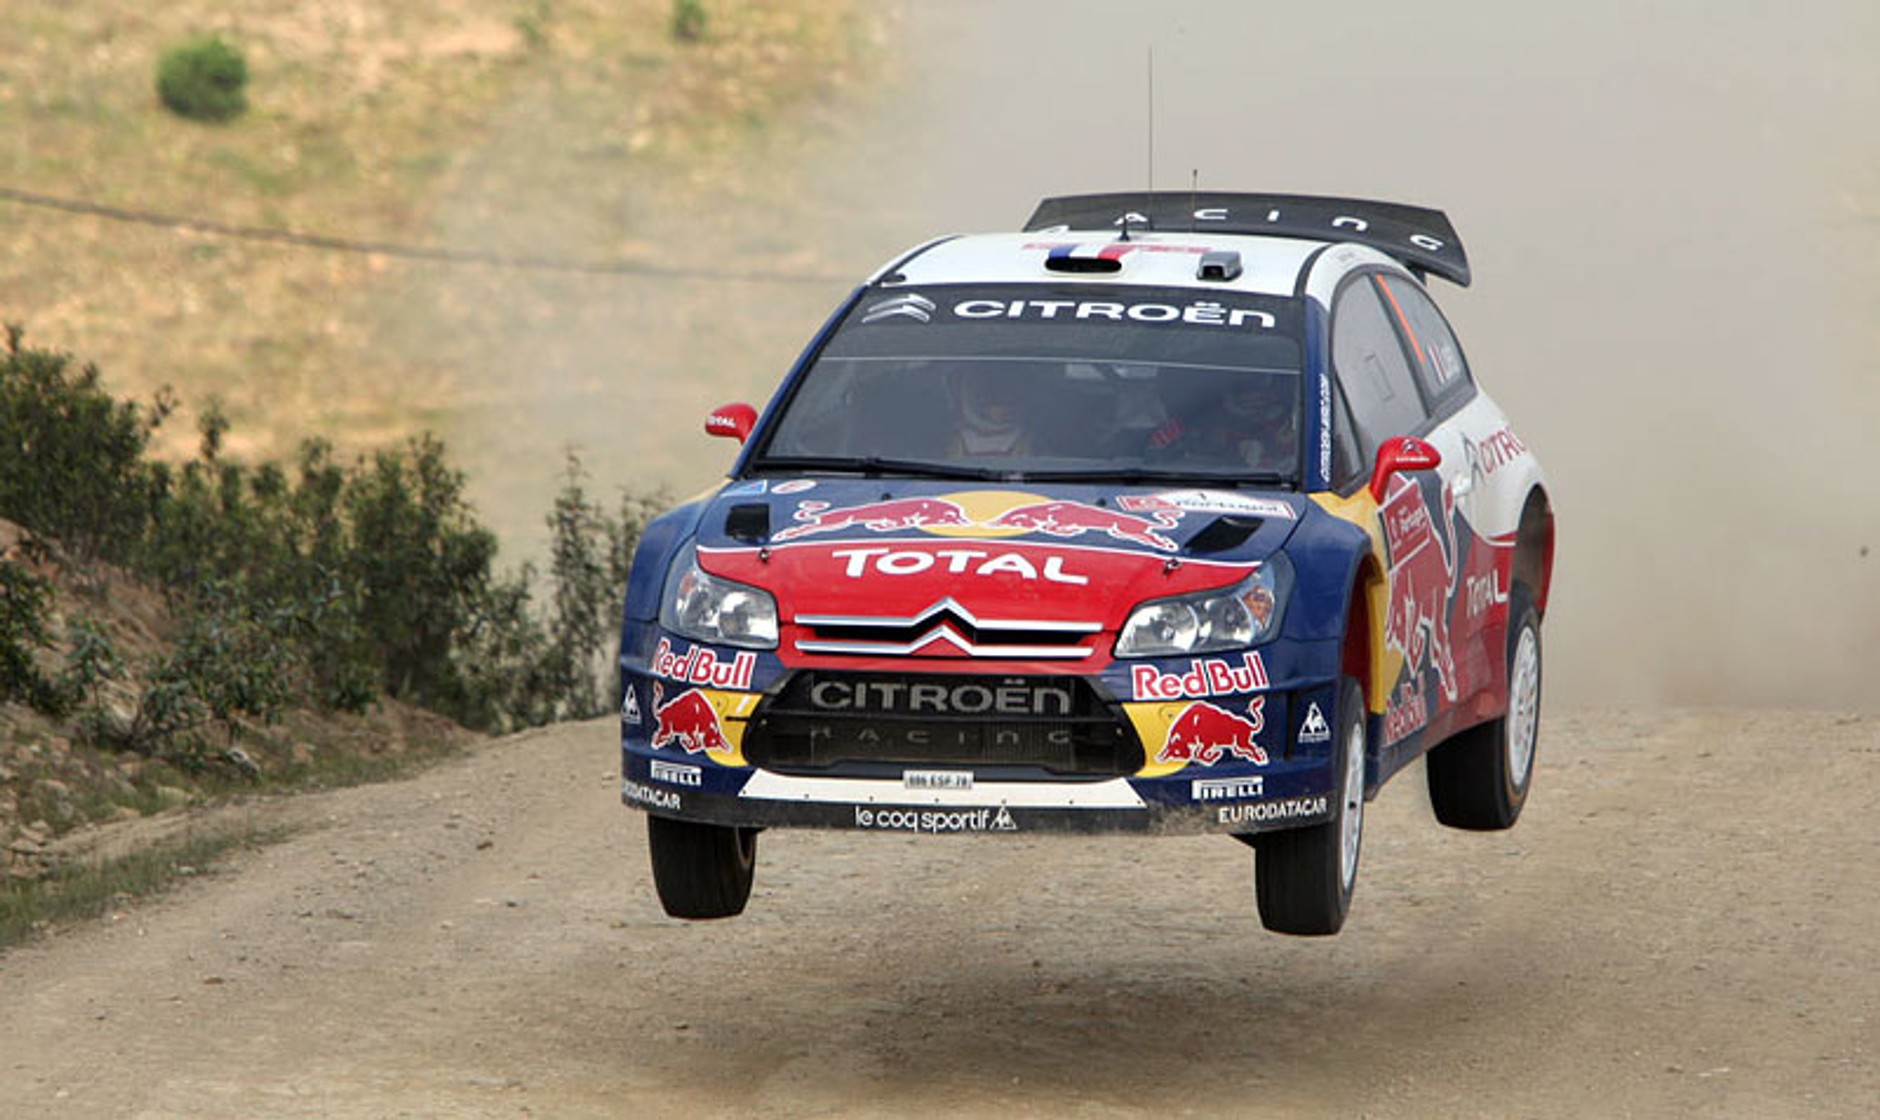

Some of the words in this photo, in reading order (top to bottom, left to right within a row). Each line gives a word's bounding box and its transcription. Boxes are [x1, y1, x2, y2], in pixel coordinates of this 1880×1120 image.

[831, 548, 1090, 586] TOTAL
[653, 635, 699, 682] Red
[689, 649, 758, 690] Bull
[1131, 659, 1209, 701] Red
[1206, 650, 1270, 695] Bull
[650, 759, 702, 786] PIRELLI
[1191, 776, 1263, 800] PIRELLI
[855, 805, 874, 827] le
[876, 810, 918, 836] coq
[921, 808, 989, 833] sportif
[1218, 798, 1327, 823] EURODATACAR
